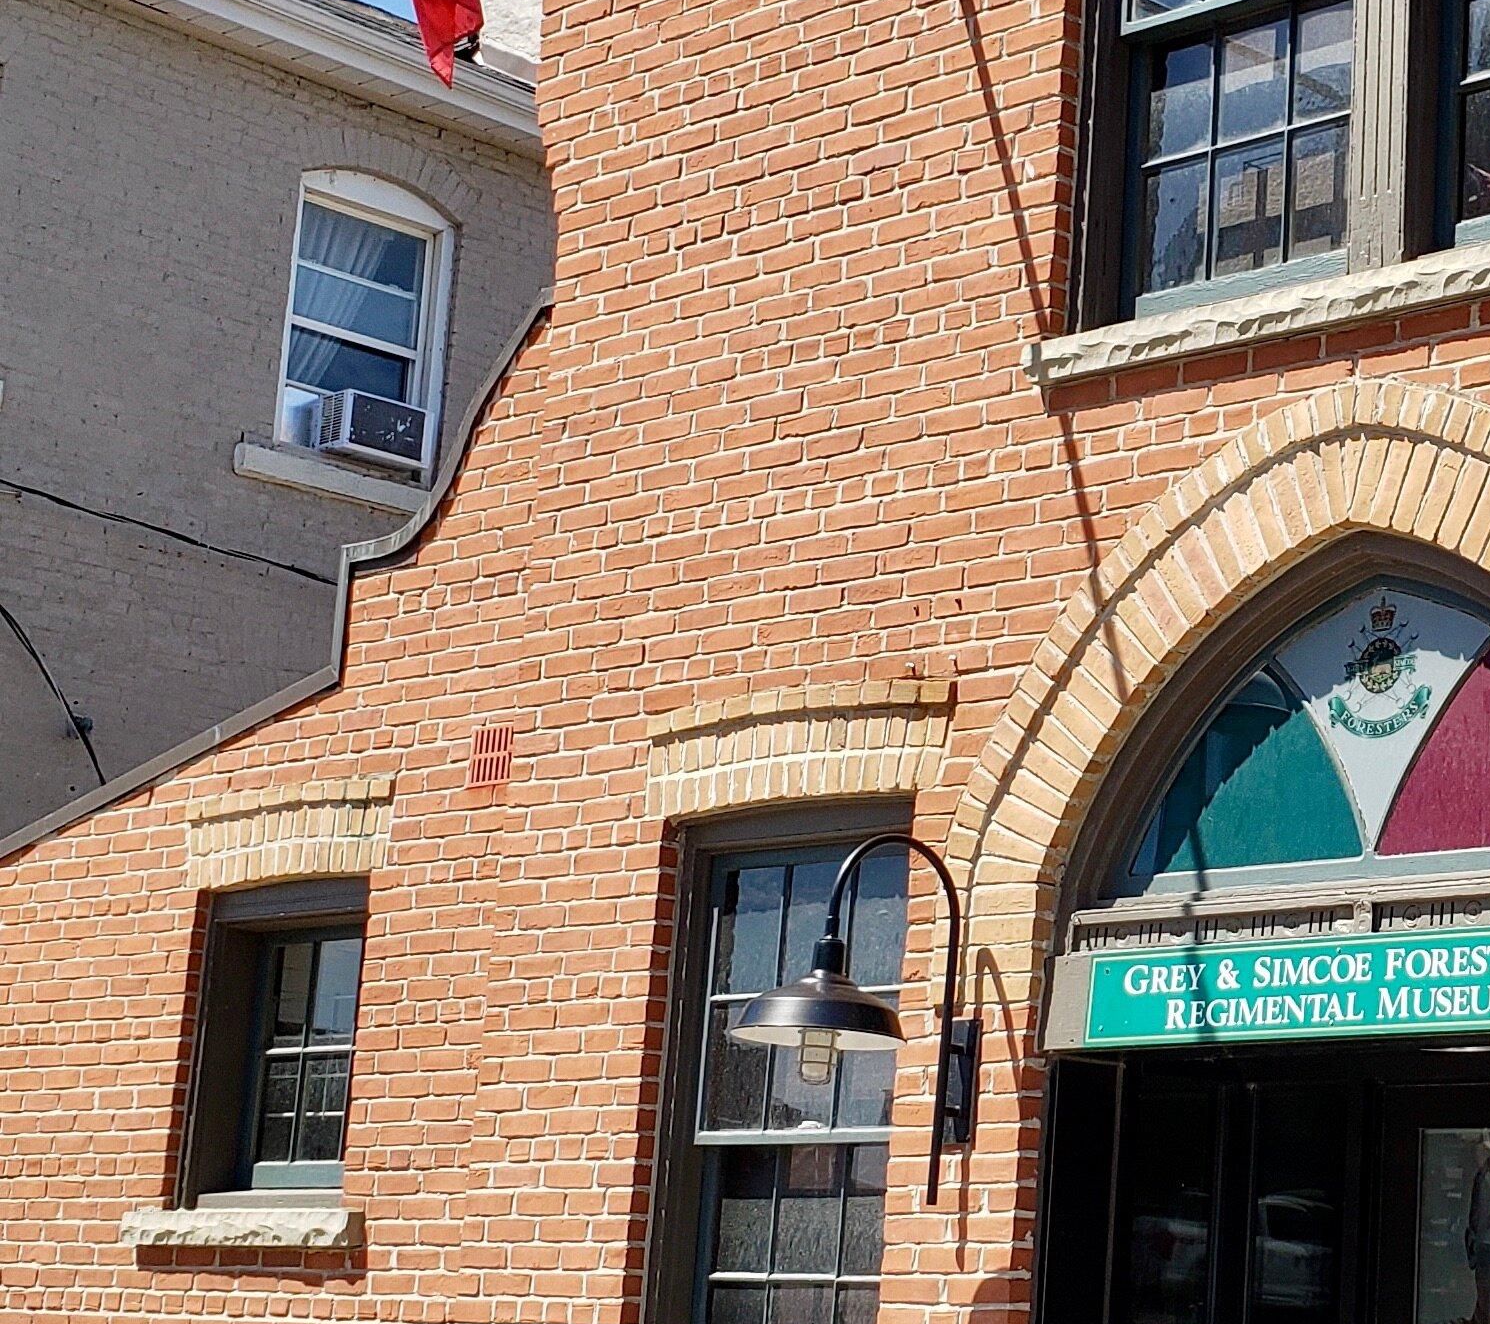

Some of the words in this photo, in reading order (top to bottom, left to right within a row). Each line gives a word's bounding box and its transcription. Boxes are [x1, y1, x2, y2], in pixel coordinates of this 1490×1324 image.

[1341, 701, 1418, 735] FORESTERS
[1124, 961, 1205, 996] GREY
[1217, 960, 1241, 991] &
[1253, 950, 1372, 987] SIMCOE
[1164, 990, 1364, 1031] REGIMENTAL
